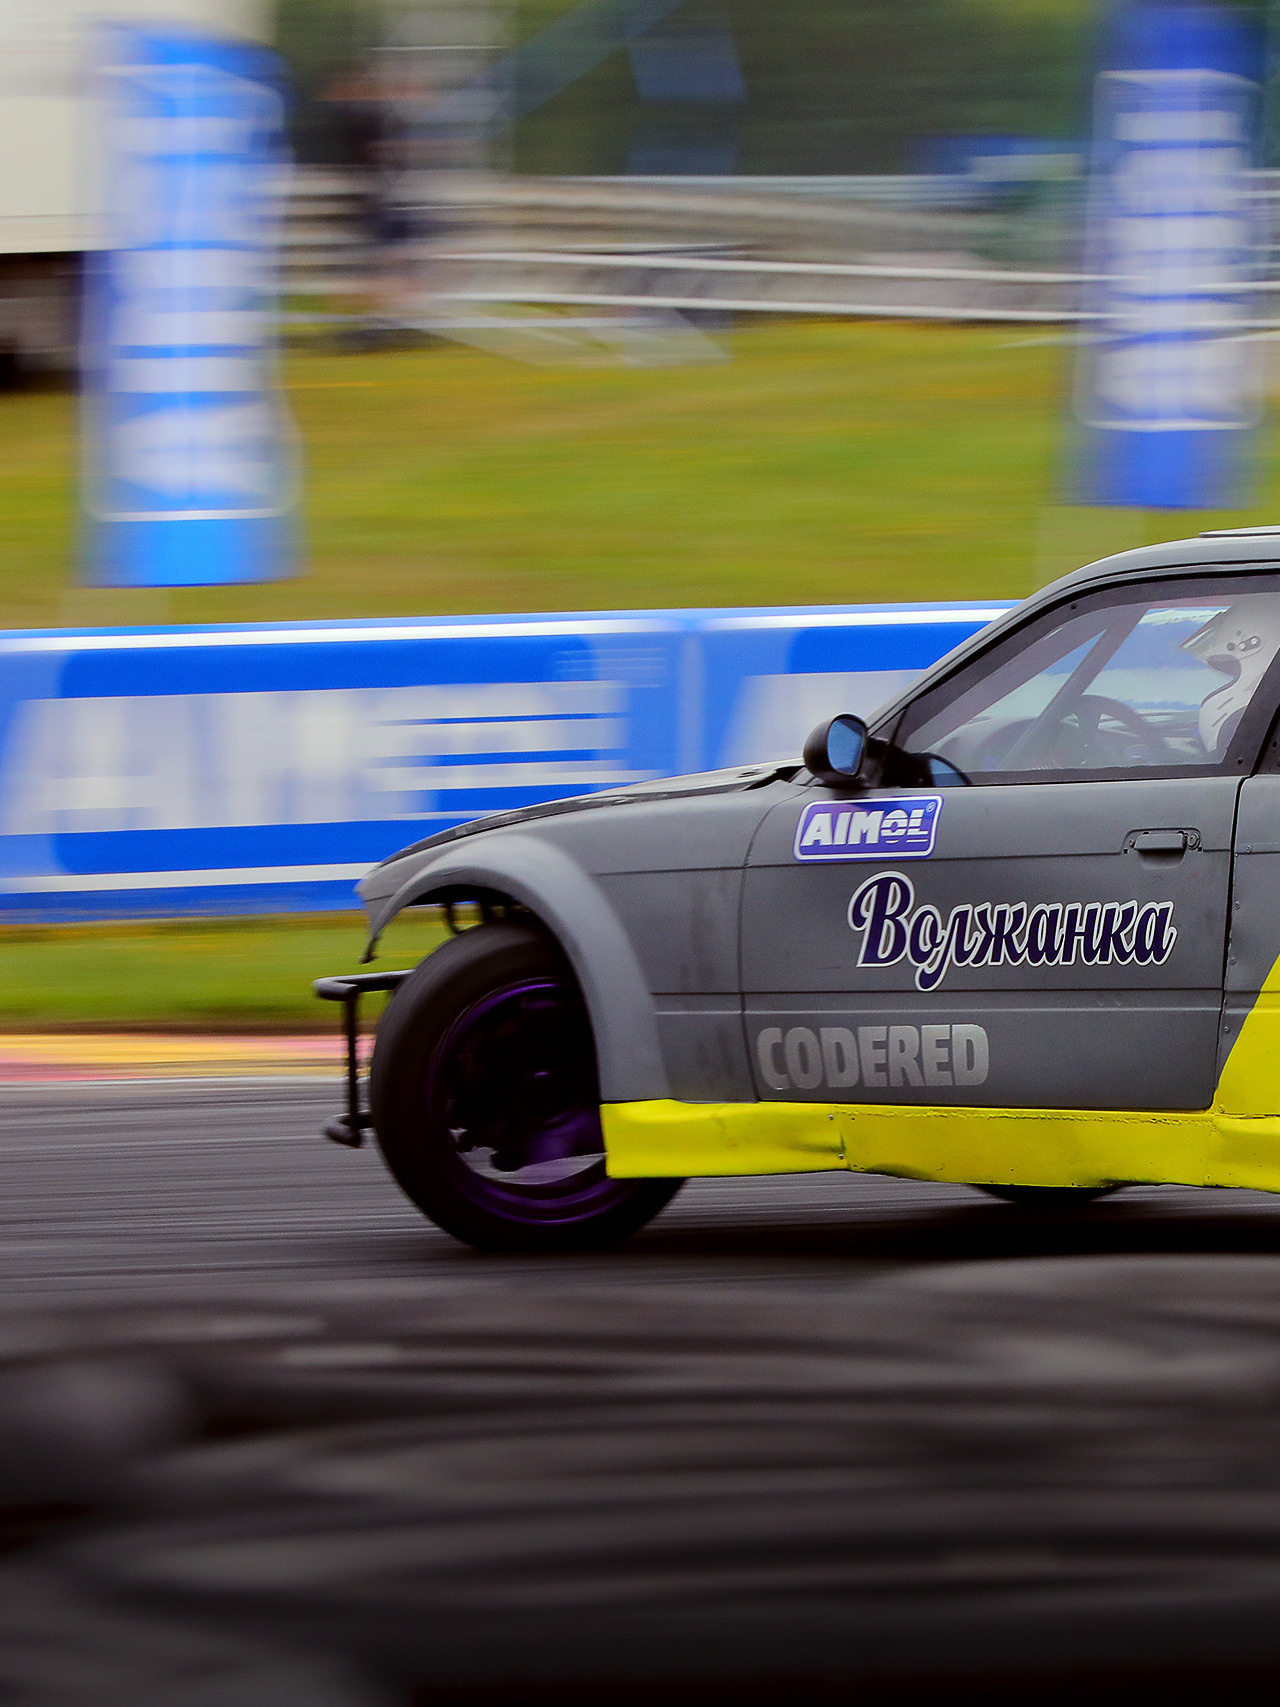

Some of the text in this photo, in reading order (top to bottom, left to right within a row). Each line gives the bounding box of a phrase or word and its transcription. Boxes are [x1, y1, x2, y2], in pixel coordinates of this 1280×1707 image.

[800, 808, 929, 847] AIMOL
[848, 871, 1178, 992] Волжанка
[757, 1023, 990, 1090] CODERED
